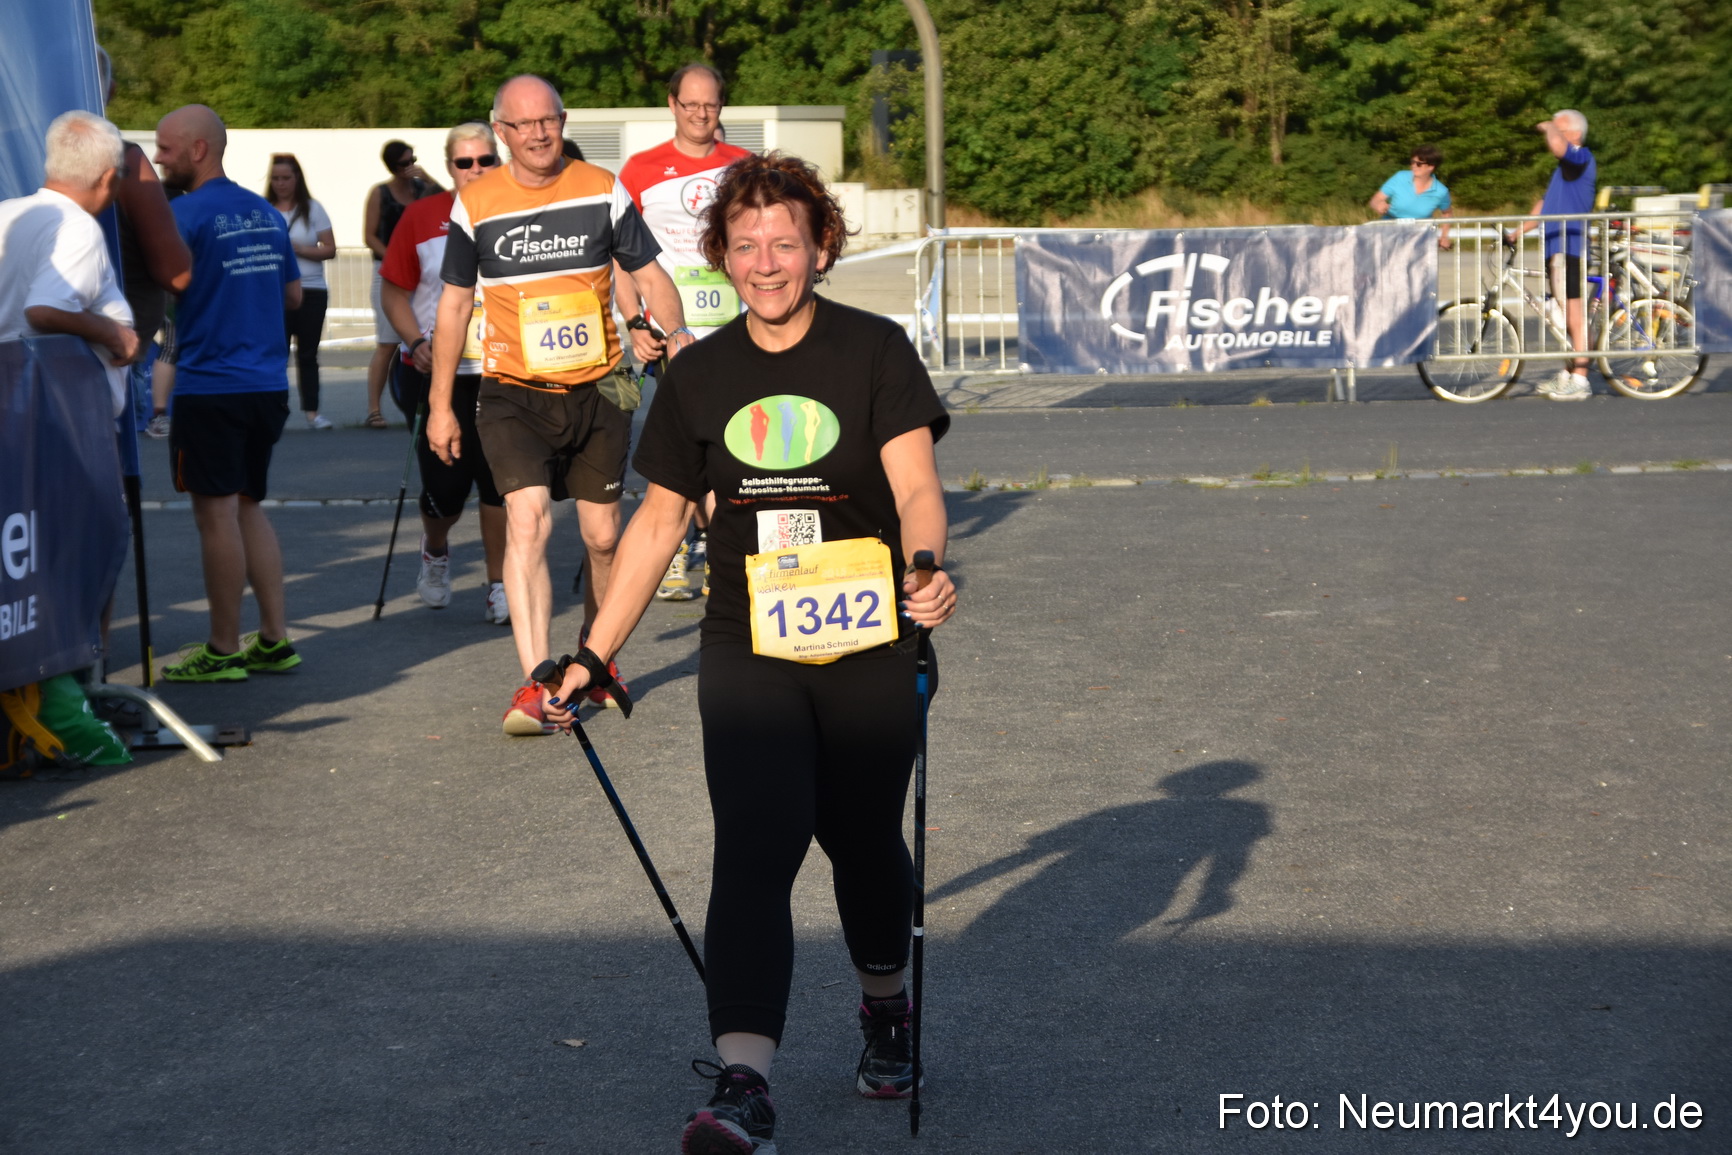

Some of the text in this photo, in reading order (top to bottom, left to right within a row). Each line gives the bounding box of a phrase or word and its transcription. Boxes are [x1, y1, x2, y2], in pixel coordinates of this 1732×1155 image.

[511, 233, 589, 256] Fischer
[520, 248, 584, 263] AUTOMOBILE
[696, 290, 721, 309] 80
[1146, 286, 1349, 329] Fischer
[540, 323, 589, 350] 466
[1165, 331, 1332, 350] AUTOMOBILE
[739, 485, 830, 495] Adipositas-Neumarkt
[742, 477, 822, 487] Selbsthilfegruppe-
[769, 564, 819, 579] firmenlauf
[768, 590, 881, 638] 1342
[794, 639, 859, 653] Martina Schmid
